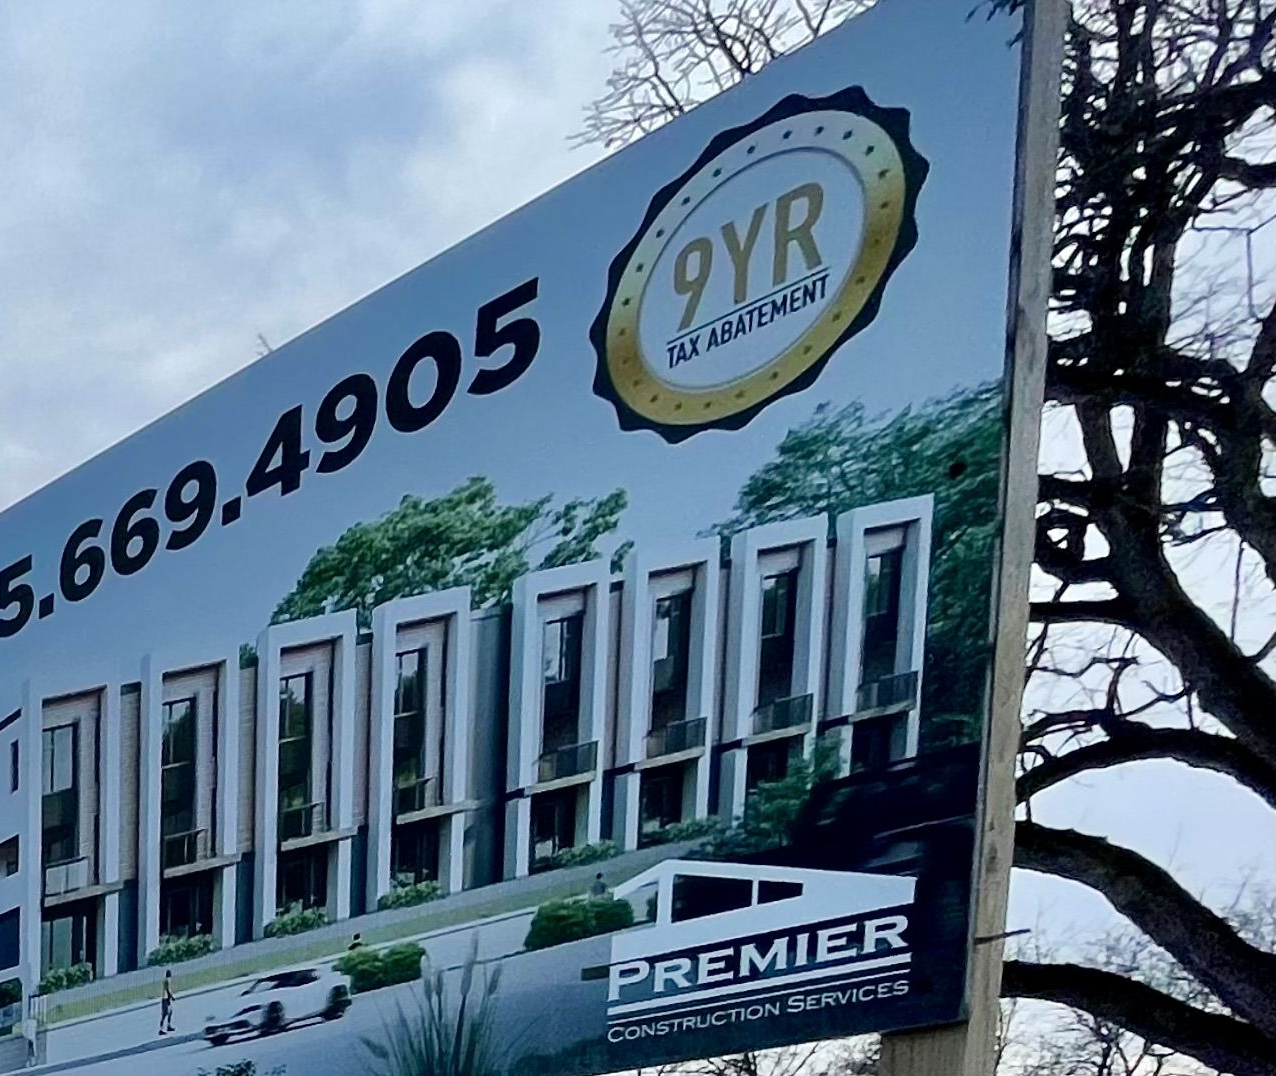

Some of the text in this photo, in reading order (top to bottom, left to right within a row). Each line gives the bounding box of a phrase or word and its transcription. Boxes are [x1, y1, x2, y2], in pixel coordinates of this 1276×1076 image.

[673, 182, 825, 333] 9YR
[667, 274, 831, 369] TAX ABATEMENT
[608, 915, 910, 1003] PREMIER
[607, 980, 910, 1044] CONSTRUCTION SERVICES
